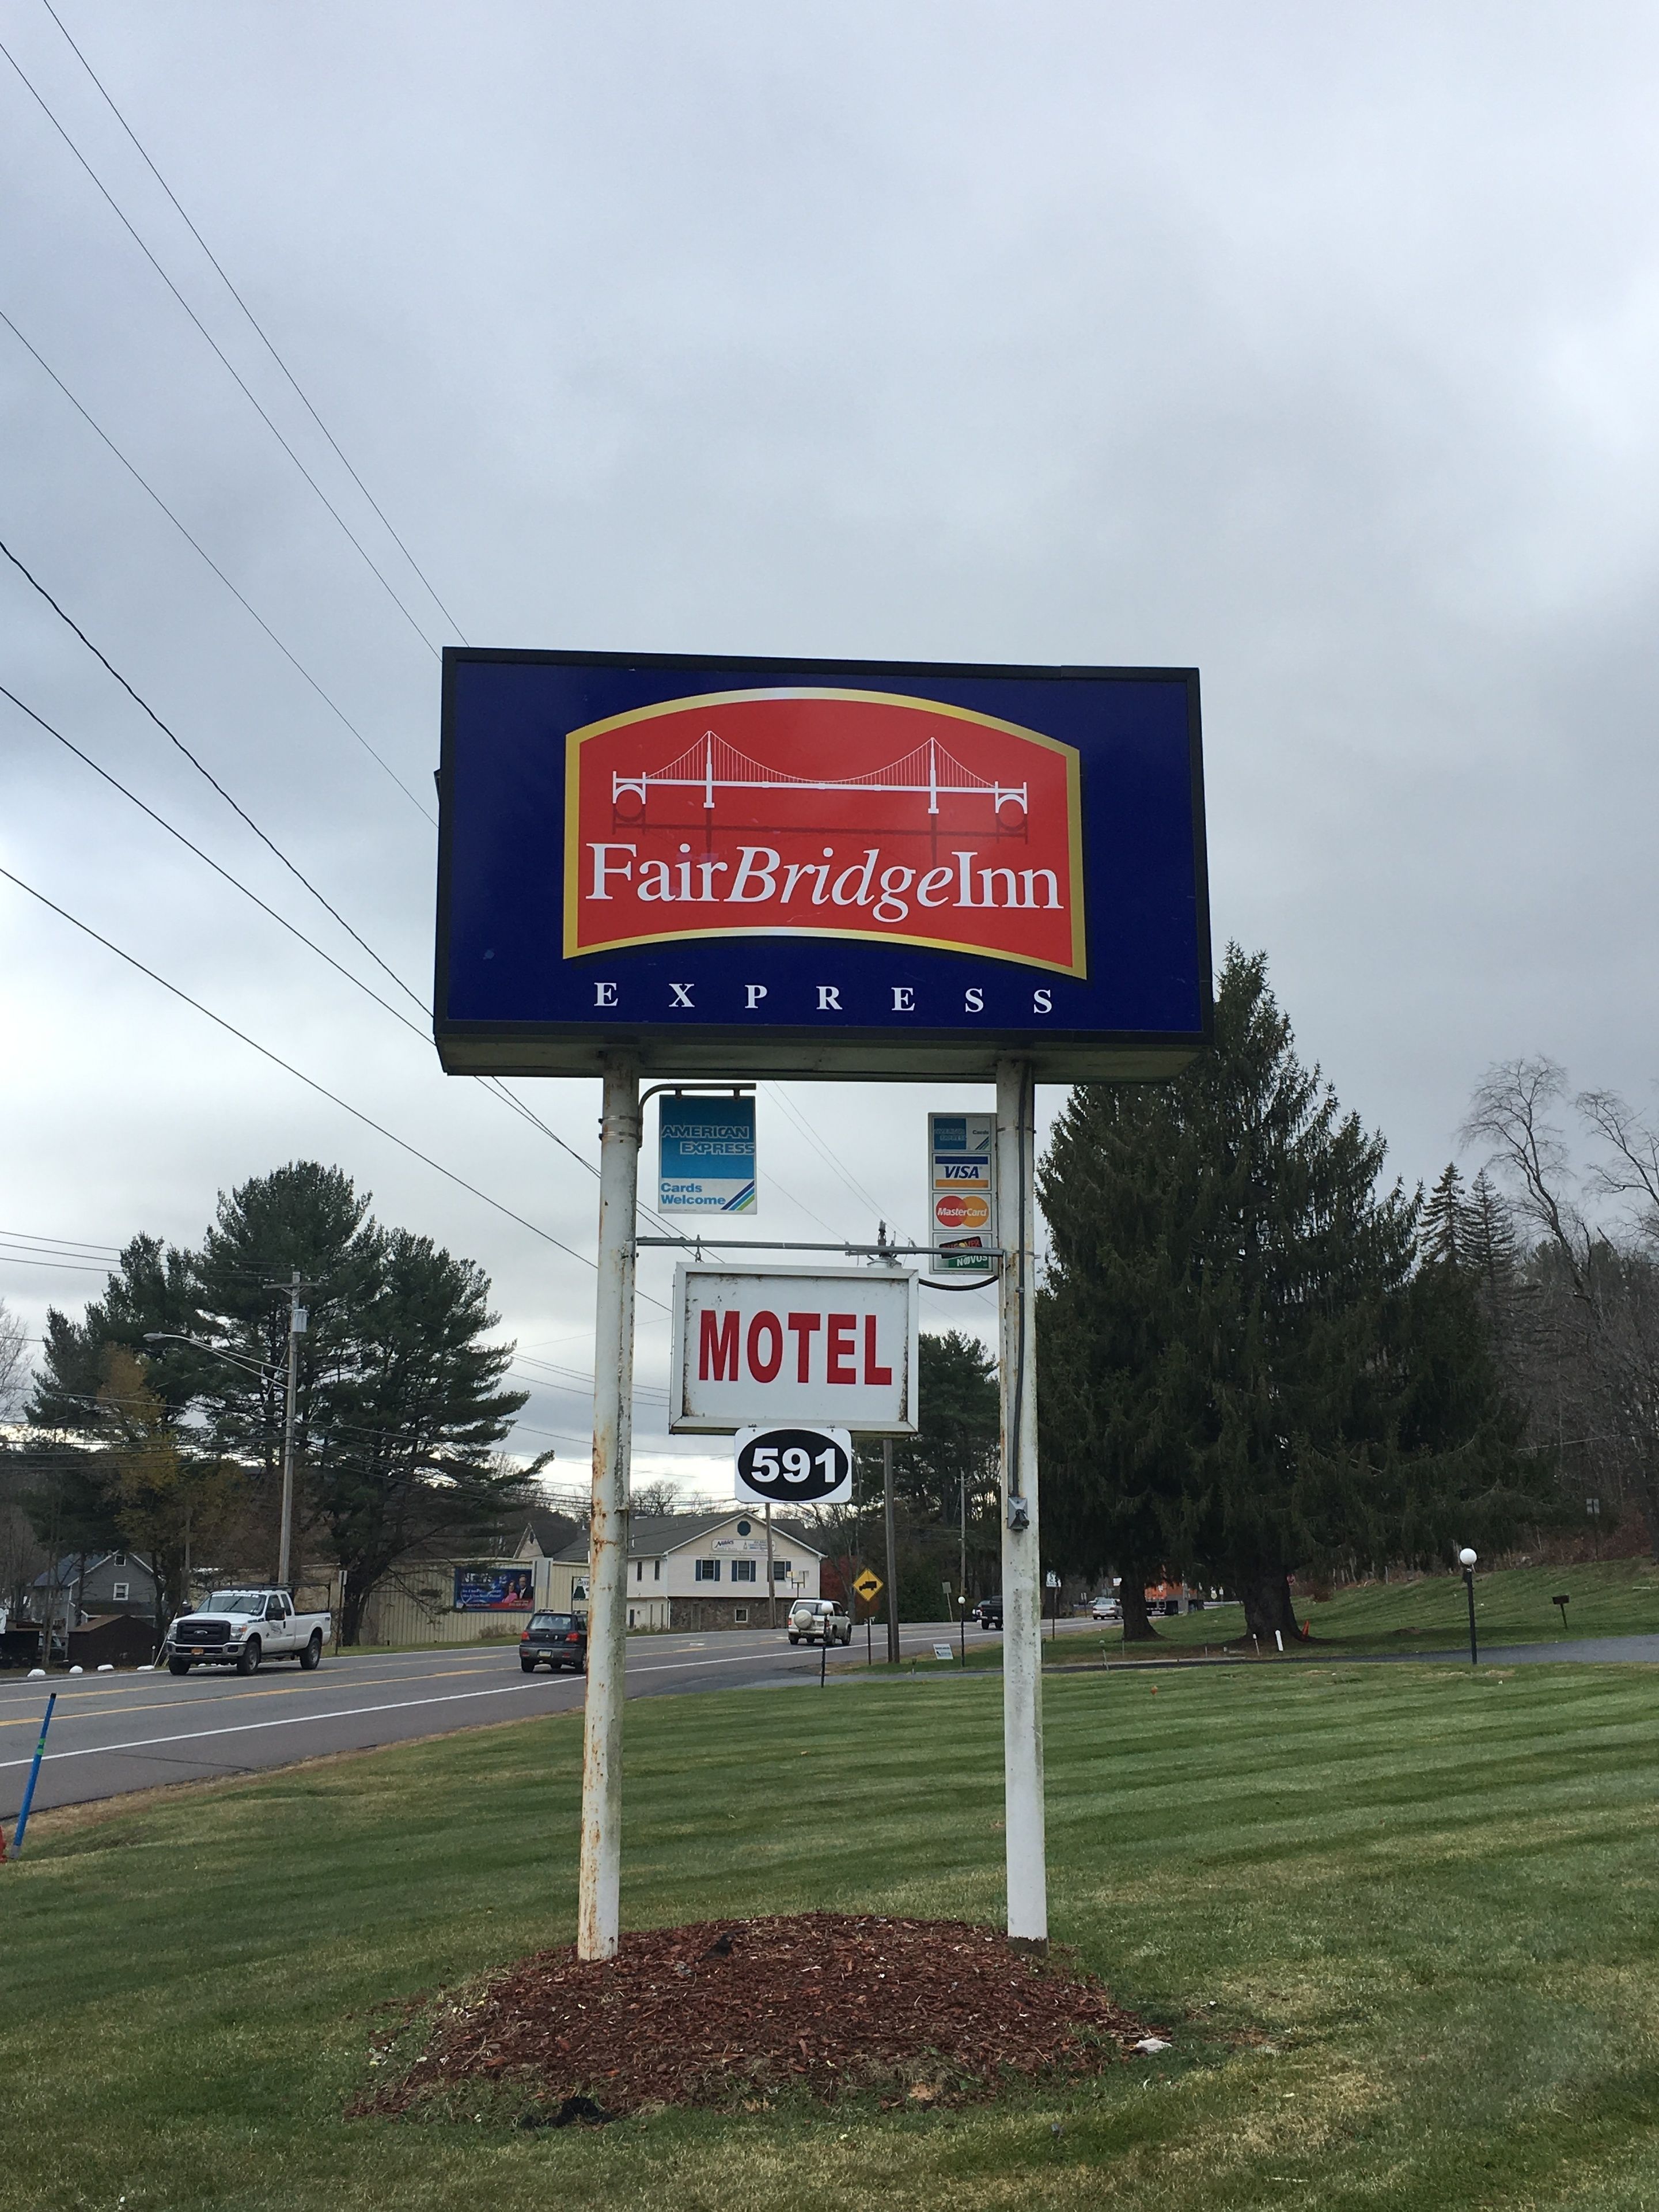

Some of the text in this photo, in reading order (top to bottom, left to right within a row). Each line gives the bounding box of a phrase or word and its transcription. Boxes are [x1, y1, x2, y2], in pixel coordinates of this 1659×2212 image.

[661, 1125, 749, 1139] AMERICAN
[680, 1141, 755, 1156] EXPRESS
[944, 1166, 979, 1179] VISA
[661, 1183, 703, 1192] Cards
[661, 1195, 726, 1205] Welcome
[937, 1207, 987, 1217] MasterCard
[699, 1310, 892, 1385] MOTEL
[751, 1448, 836, 1483] 591
